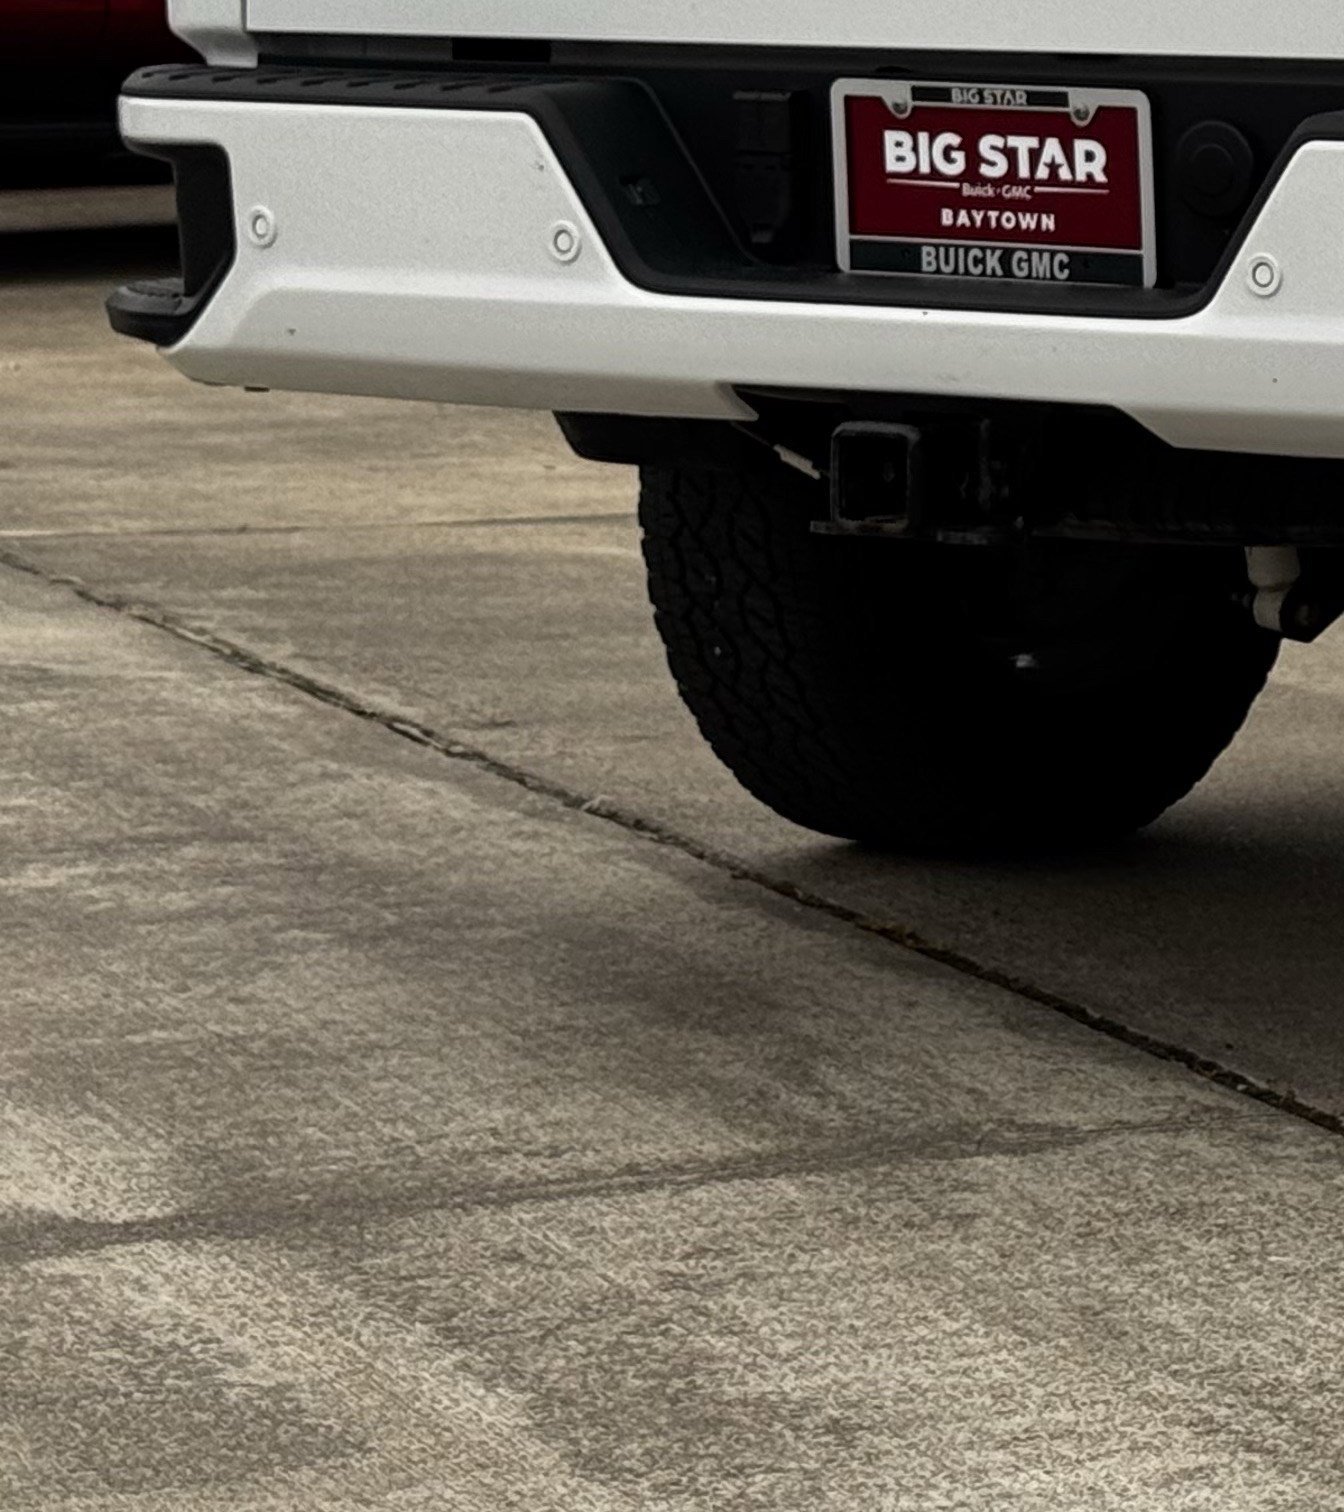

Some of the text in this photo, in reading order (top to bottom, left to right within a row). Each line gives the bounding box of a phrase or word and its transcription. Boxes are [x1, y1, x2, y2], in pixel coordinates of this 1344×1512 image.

[951, 88, 1028, 106] BIG STAR
[883, 129, 1108, 183] BIG STAR
[941, 208, 1056, 232] BAYTOWN
[921, 246, 1070, 280] BUICK GMC
